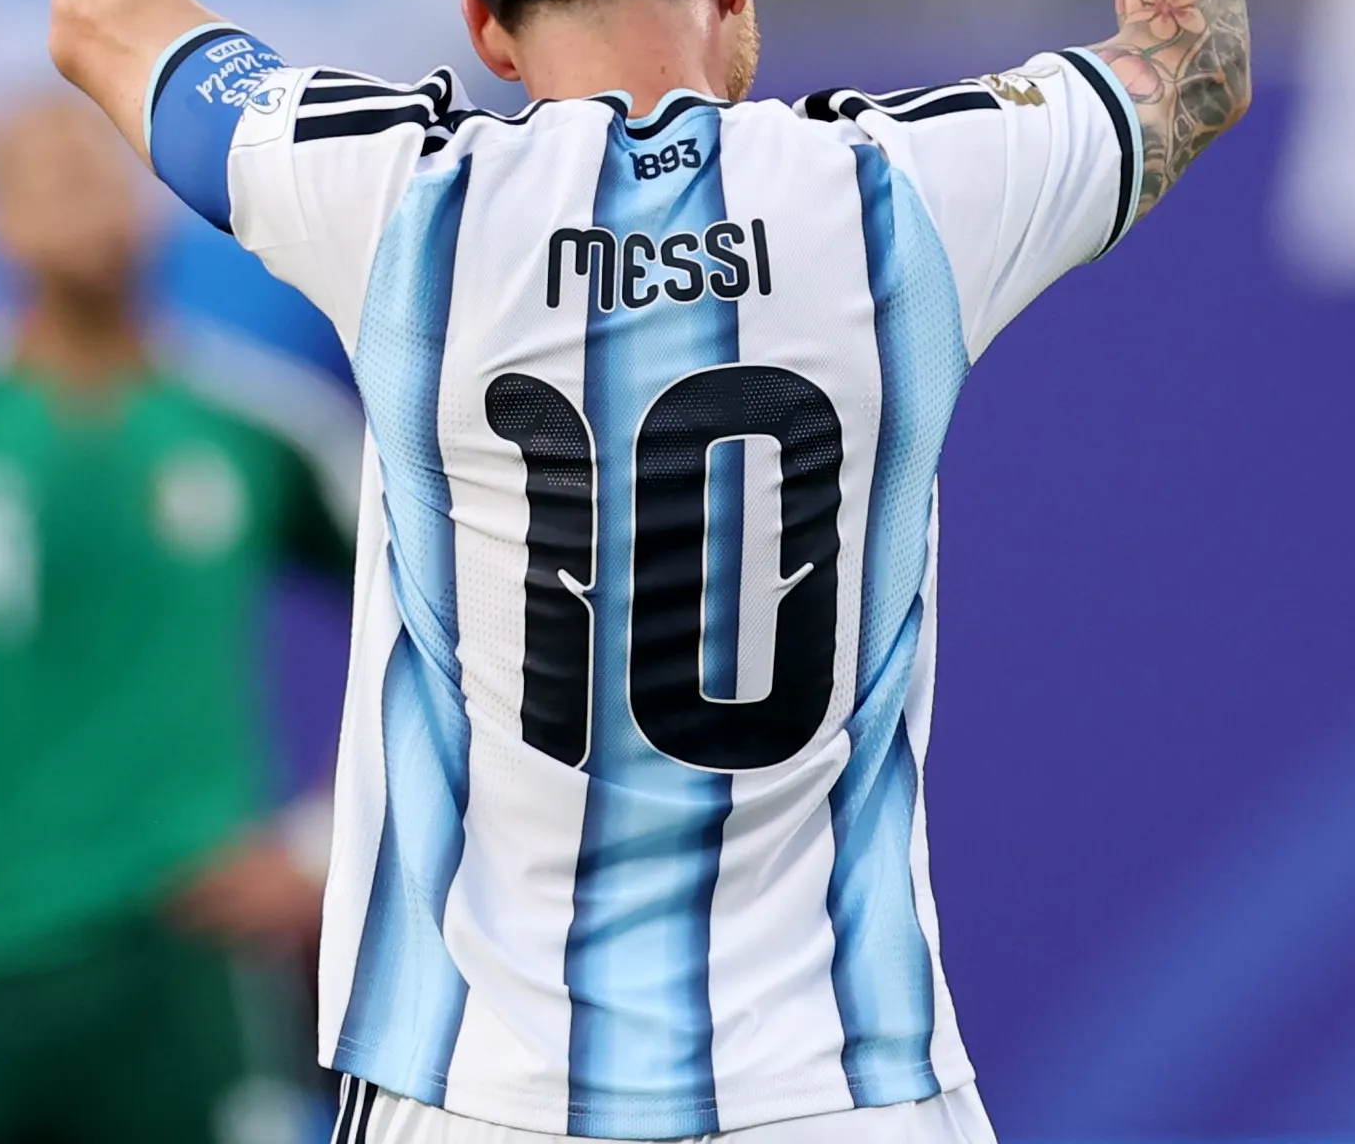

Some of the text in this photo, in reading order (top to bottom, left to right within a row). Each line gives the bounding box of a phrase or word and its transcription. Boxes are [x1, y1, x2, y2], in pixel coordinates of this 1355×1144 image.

[210, 40, 248, 58] FIFA
[195, 53, 263, 103] World
[631, 137, 702, 181] 1893
[545, 217, 773, 314] MESSI
[484, 362, 845, 775] 10
